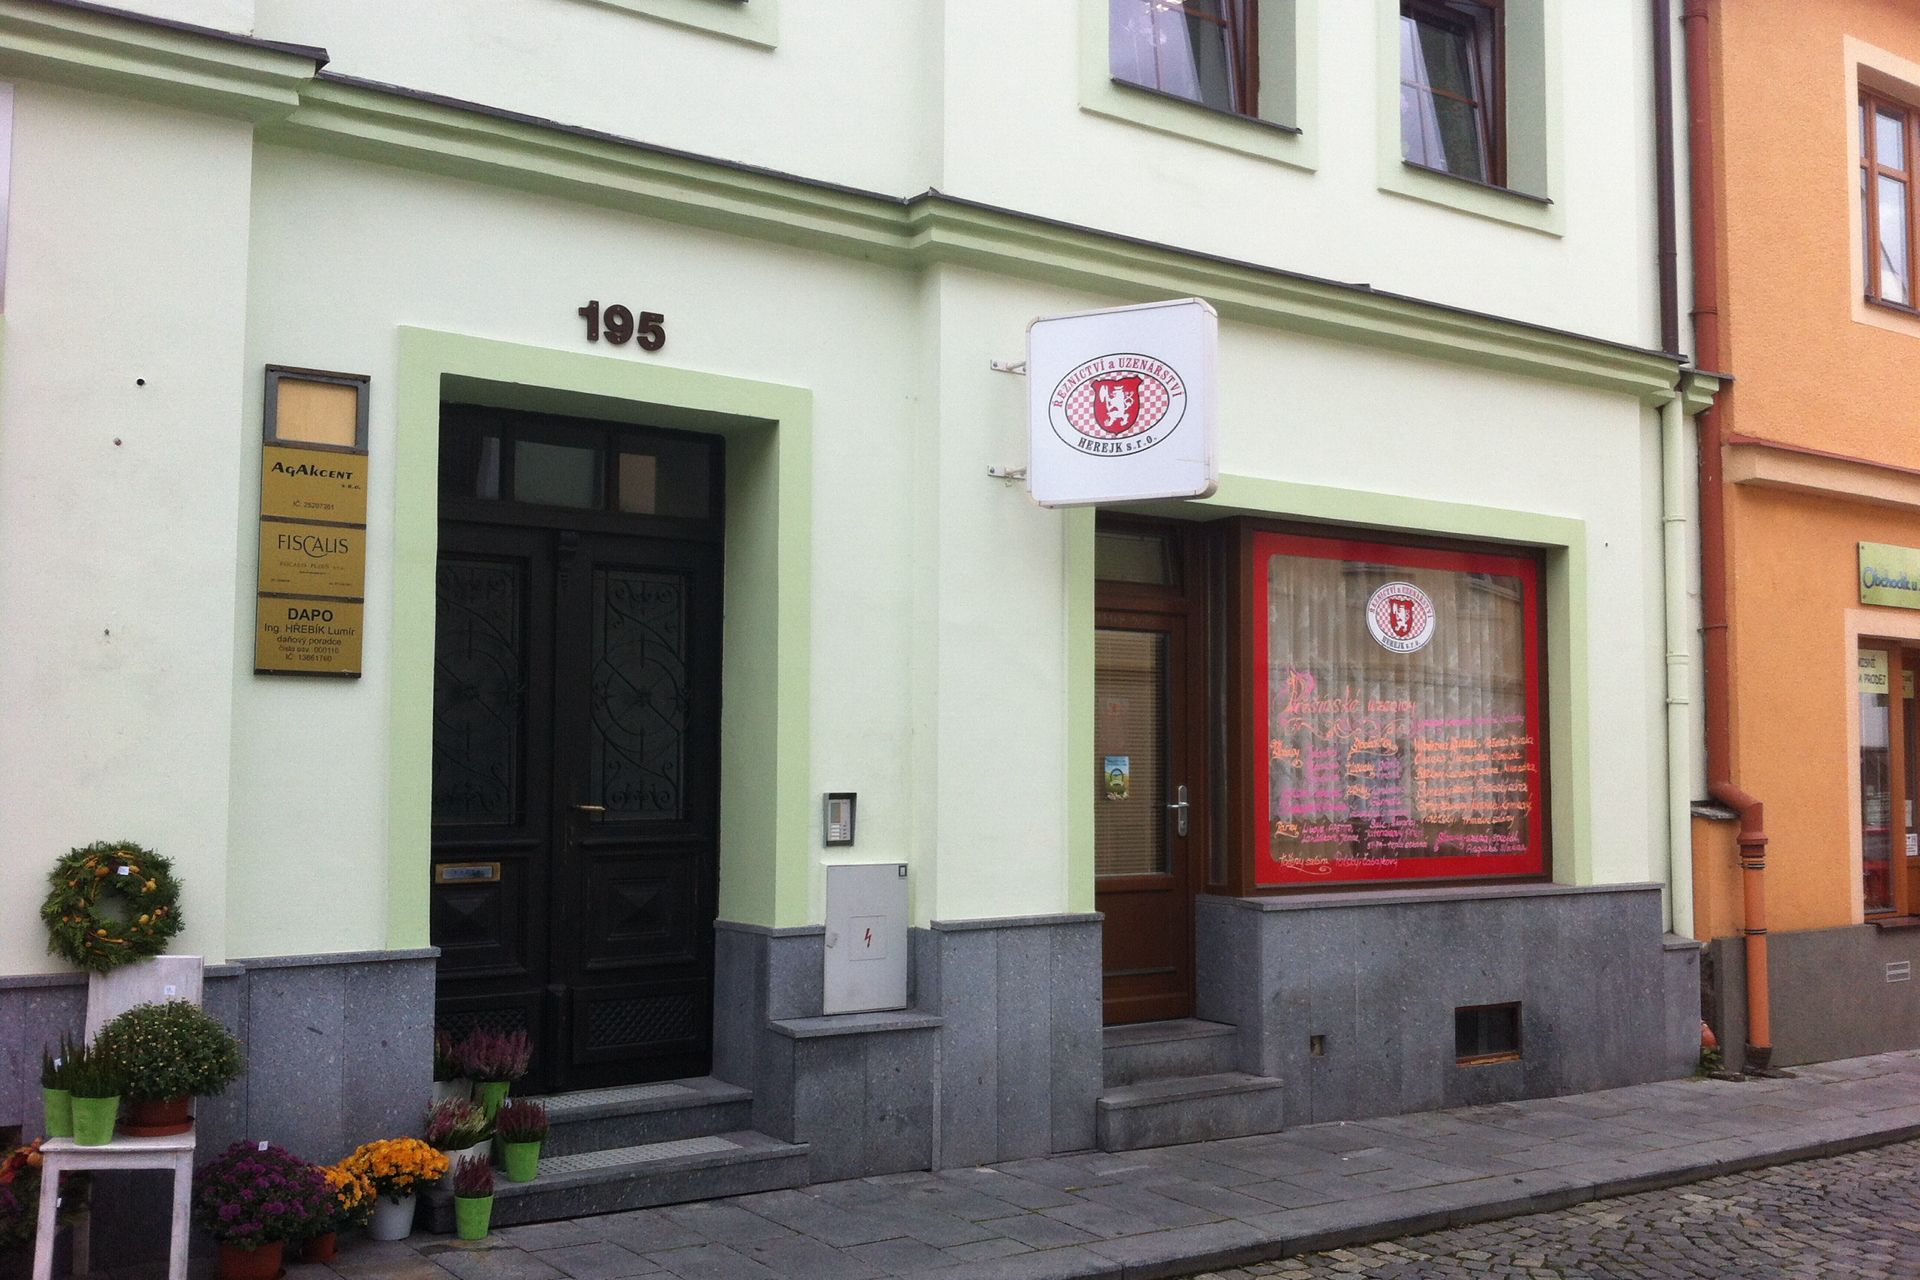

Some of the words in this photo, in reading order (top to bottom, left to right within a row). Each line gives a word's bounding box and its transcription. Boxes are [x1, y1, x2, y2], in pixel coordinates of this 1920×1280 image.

[578, 300, 666, 351] 195
[1053, 358, 1105, 408] ŘEZNICTVÍ
[1108, 361, 1115, 369] a
[1118, 357, 1183, 398] UZENÁŘSTVÍ
[1077, 437, 1123, 453] HEREJK
[278, 534, 349, 559] FISCALIS
[288, 608, 334, 622] DAPO
[285, 623, 326, 635] HŘEBÍK
[328, 626, 356, 636] Lumír
[309, 637, 342, 645] poradce
